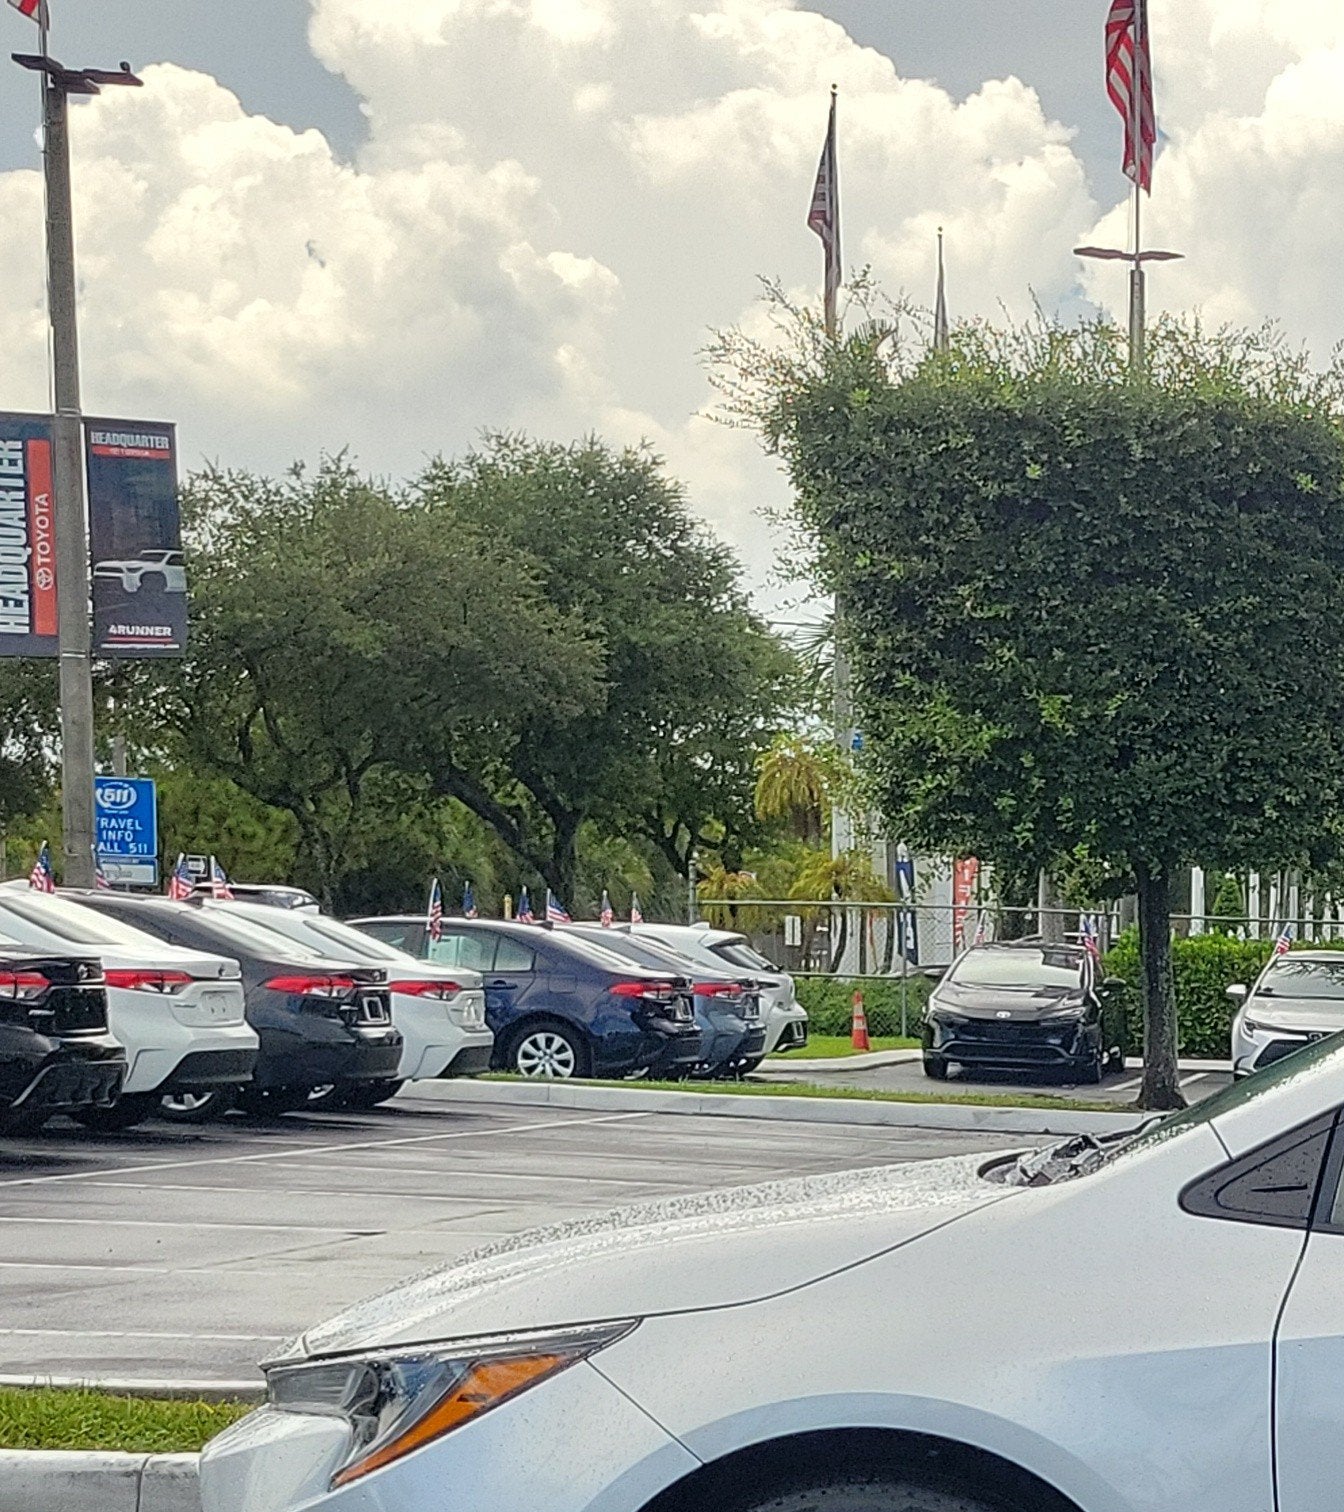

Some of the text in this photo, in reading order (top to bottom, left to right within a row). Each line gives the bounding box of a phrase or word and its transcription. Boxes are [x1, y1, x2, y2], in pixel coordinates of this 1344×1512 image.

[90, 431, 169, 449] HEADQUARTER
[35, 493, 51, 566] TOYOTA
[108, 624, 172, 637] 4RUNNER
[103, 788, 129, 803] 511
[102, 830, 133, 842] INFO
[97, 841, 148, 854] ALL 511
